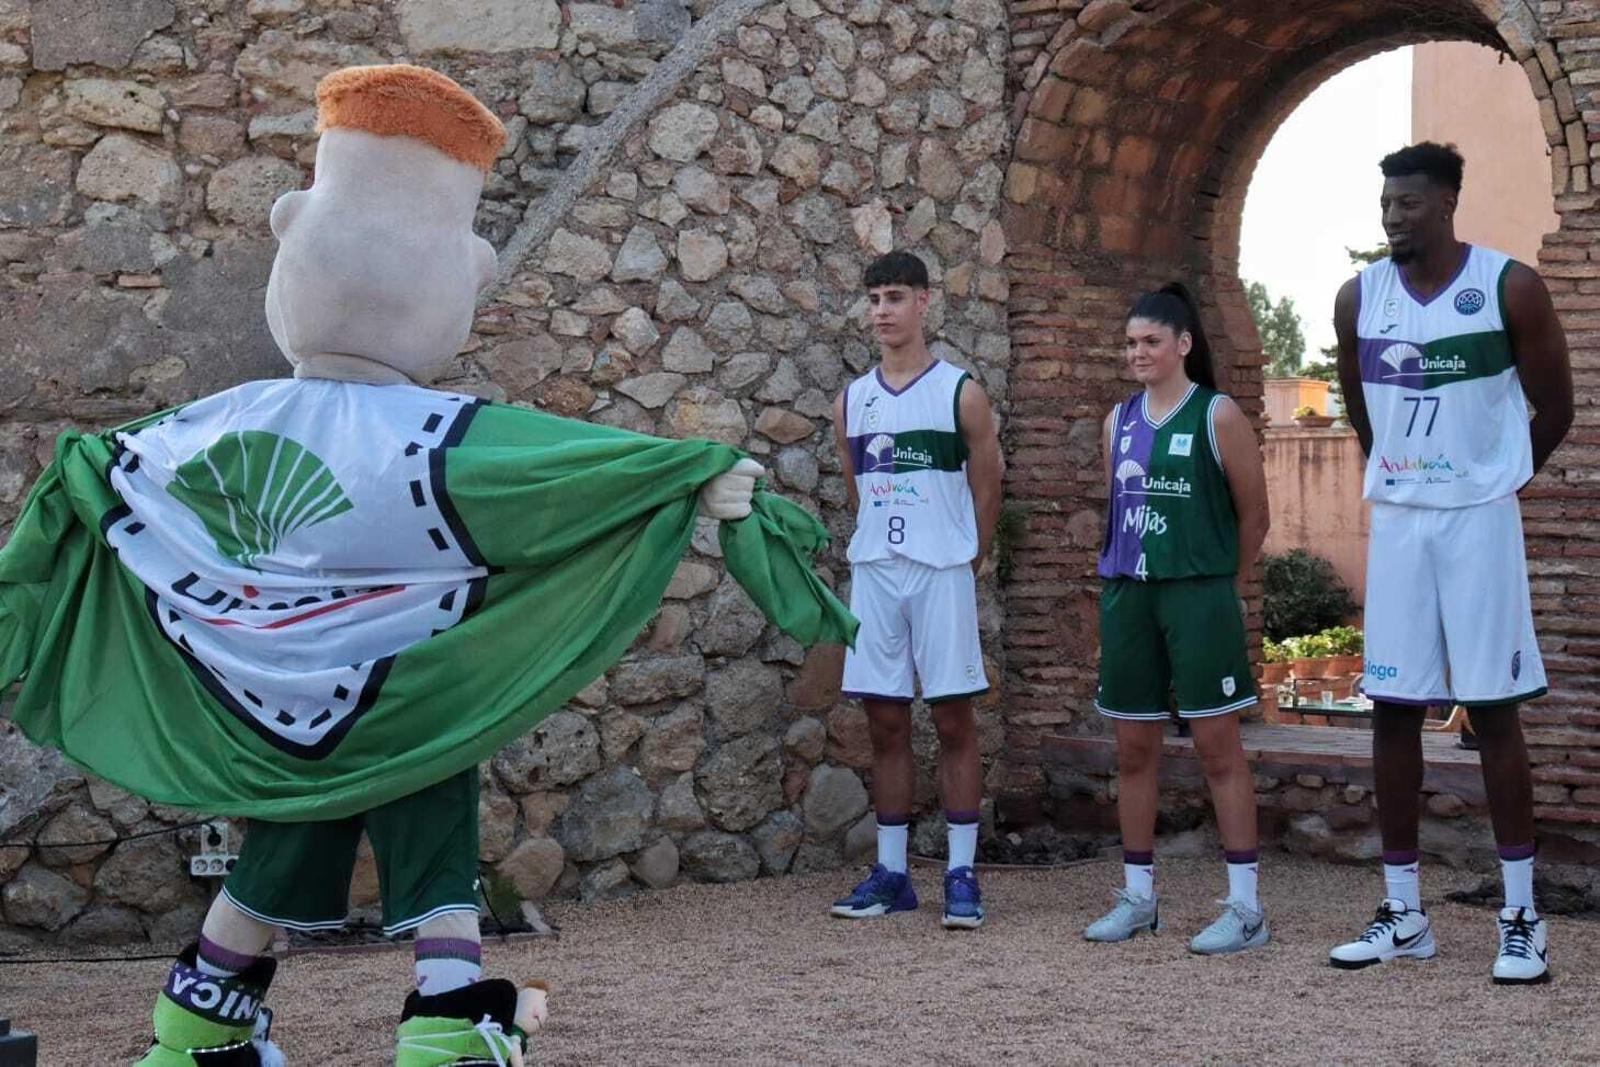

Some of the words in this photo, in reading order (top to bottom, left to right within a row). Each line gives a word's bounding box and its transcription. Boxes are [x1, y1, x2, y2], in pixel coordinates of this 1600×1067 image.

[1418, 355, 1466, 371] Unicaja
[1403, 396, 1440, 437] 77
[892, 447, 933, 464] Unicaja
[1141, 476, 1191, 494] Unicaja
[888, 516, 906, 545] 8
[1122, 504, 1168, 539] Mijas
[1134, 552, 1149, 581] 4
[1364, 661, 1397, 680] laga
